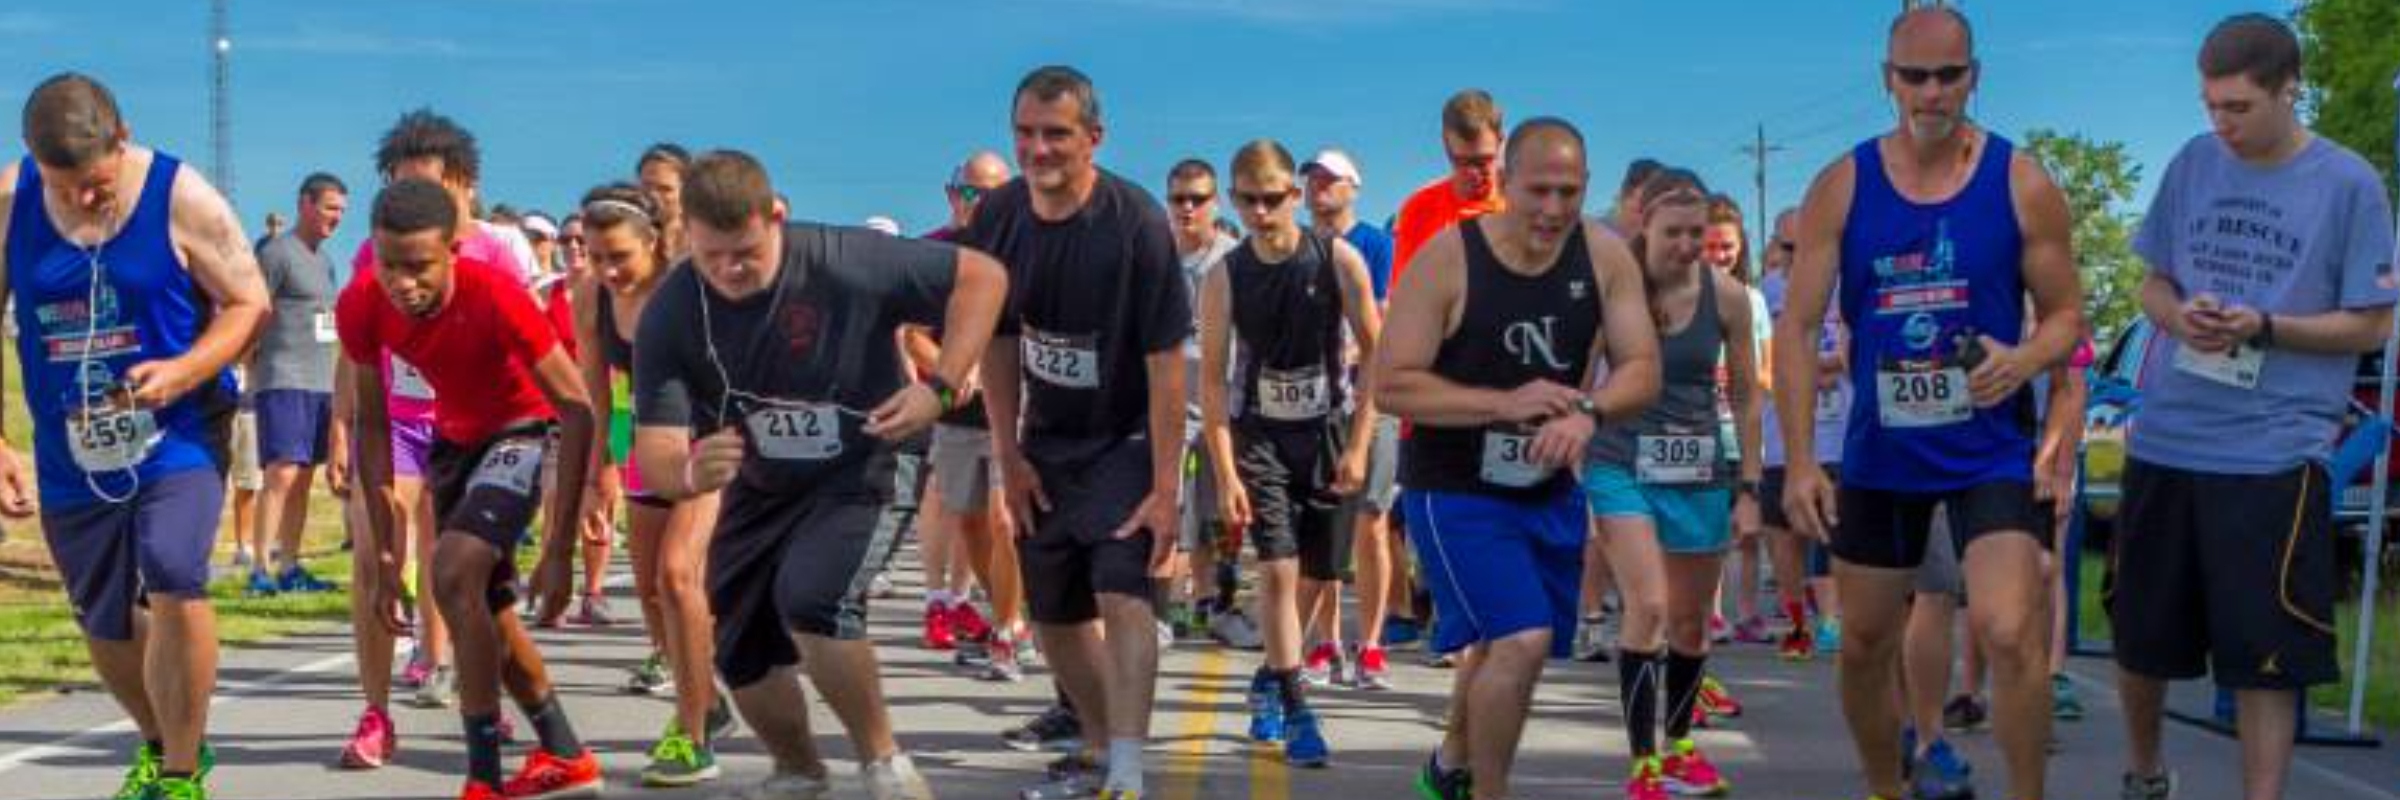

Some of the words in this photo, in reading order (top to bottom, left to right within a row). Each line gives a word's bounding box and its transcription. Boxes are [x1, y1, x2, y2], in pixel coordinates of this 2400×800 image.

[1504, 316, 1571, 370] N
[1032, 345, 1081, 377] 222
[1893, 374, 1950, 402] 208
[763, 411, 822, 436] 212
[1652, 438, 1700, 462] 309
